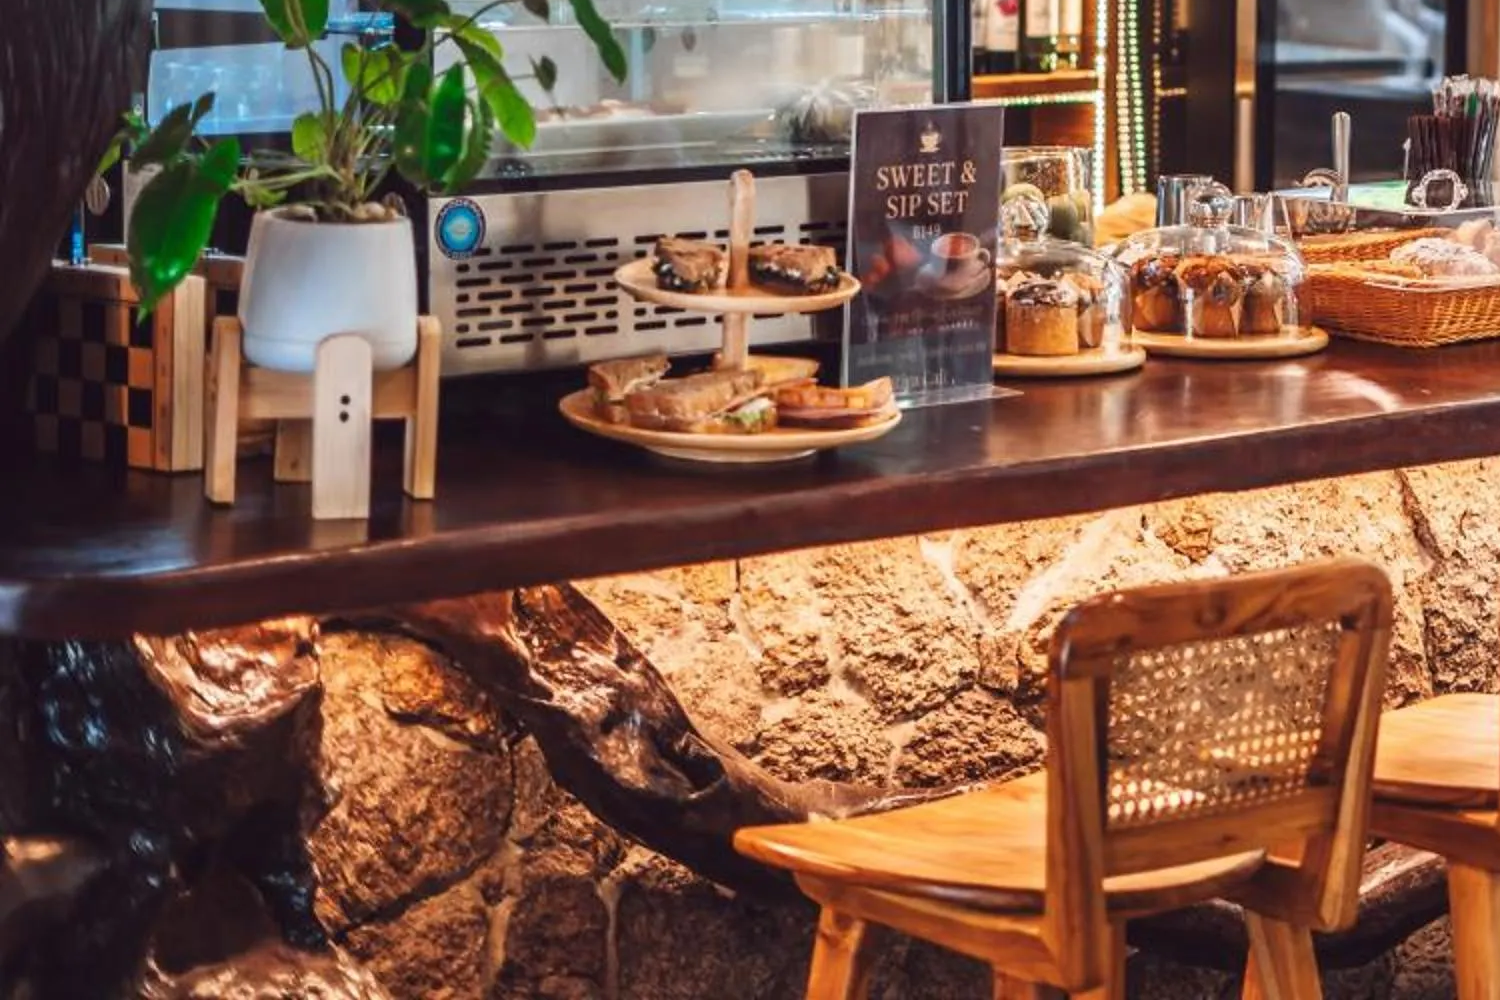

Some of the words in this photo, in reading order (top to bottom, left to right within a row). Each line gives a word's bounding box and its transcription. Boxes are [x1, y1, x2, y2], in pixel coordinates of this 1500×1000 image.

[876, 161, 956, 191] SWEET
[960, 160, 977, 184] &
[885, 197, 922, 220] SIP
[927, 191, 969, 215] SET
